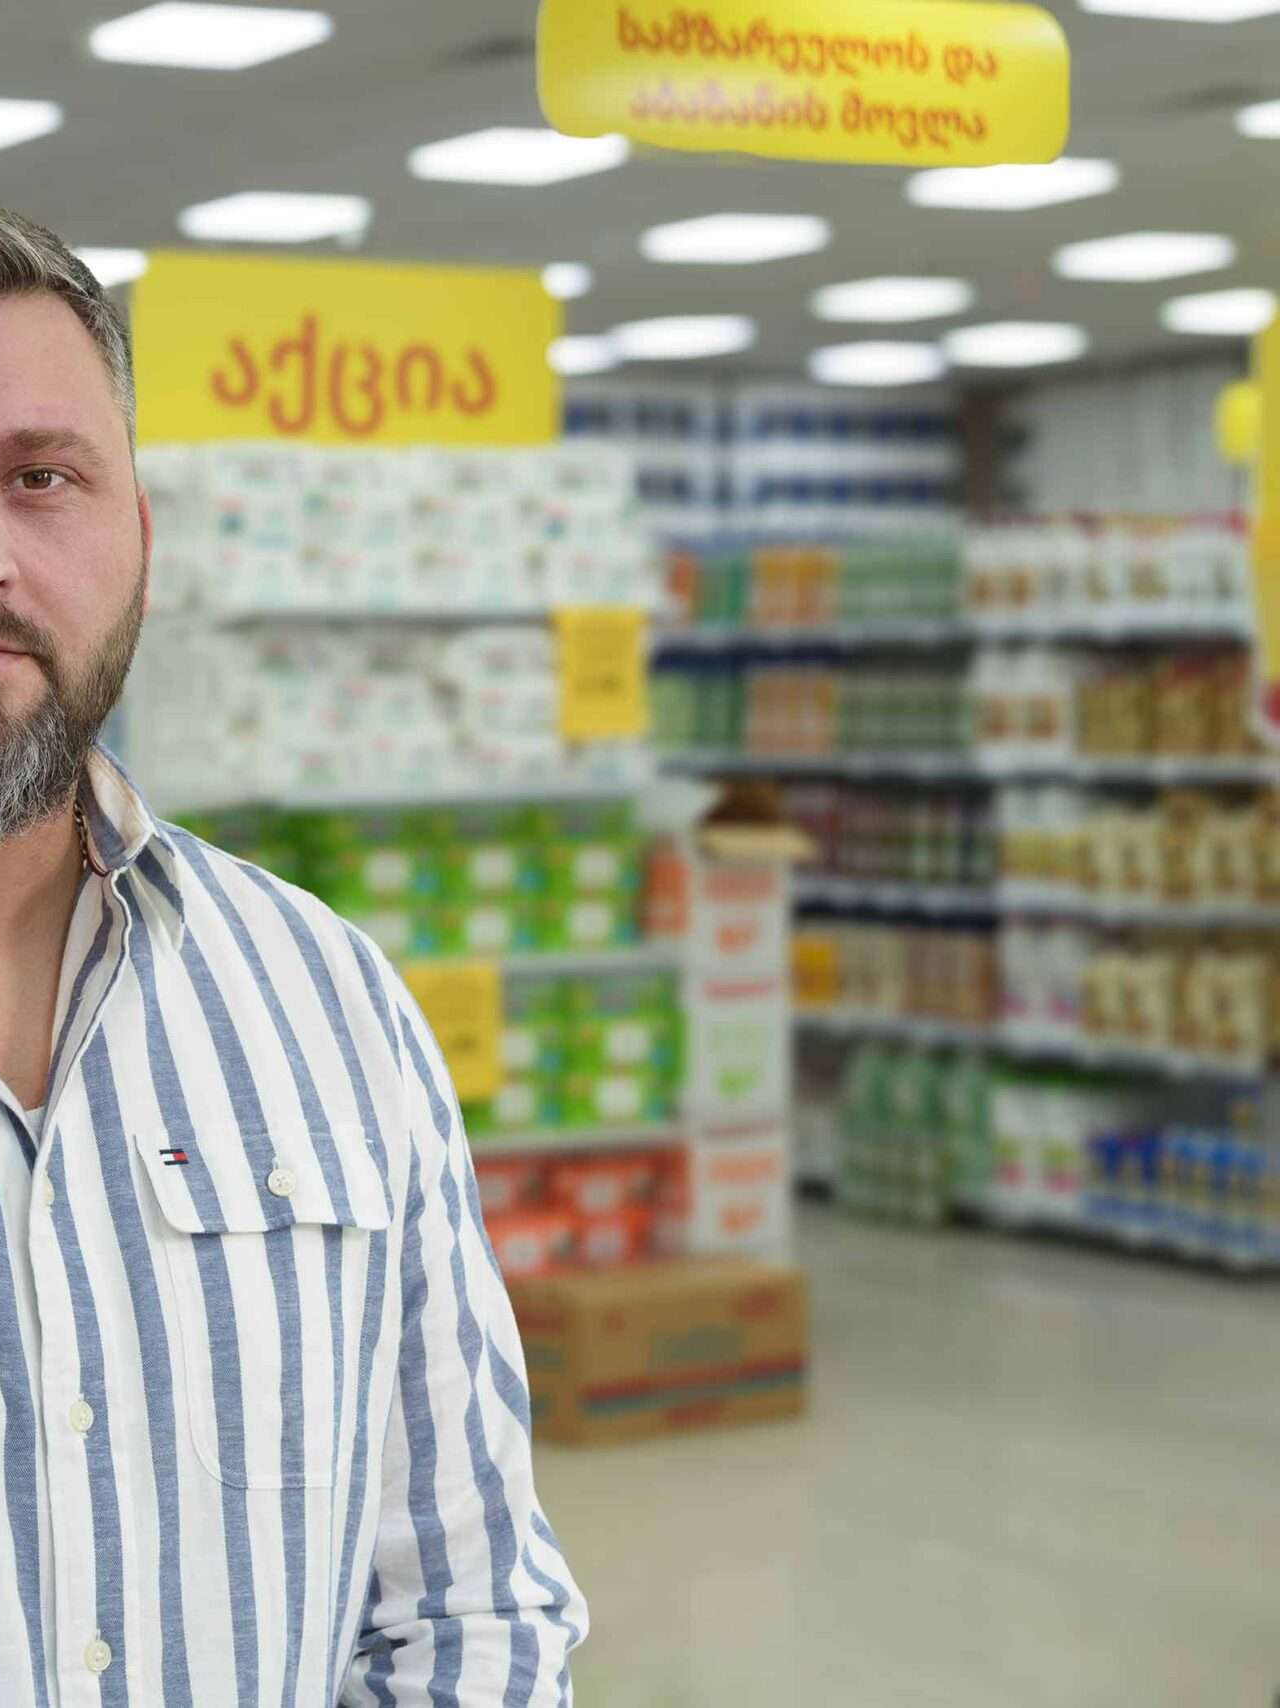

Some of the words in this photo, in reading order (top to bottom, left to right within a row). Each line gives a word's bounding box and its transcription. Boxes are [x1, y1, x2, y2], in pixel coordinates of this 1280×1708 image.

[615, 7, 930, 77] სამზარეულოს
[942, 43, 999, 86] და
[840, 87, 987, 150] მოვლა
[208, 310, 500, 438] აქცია
